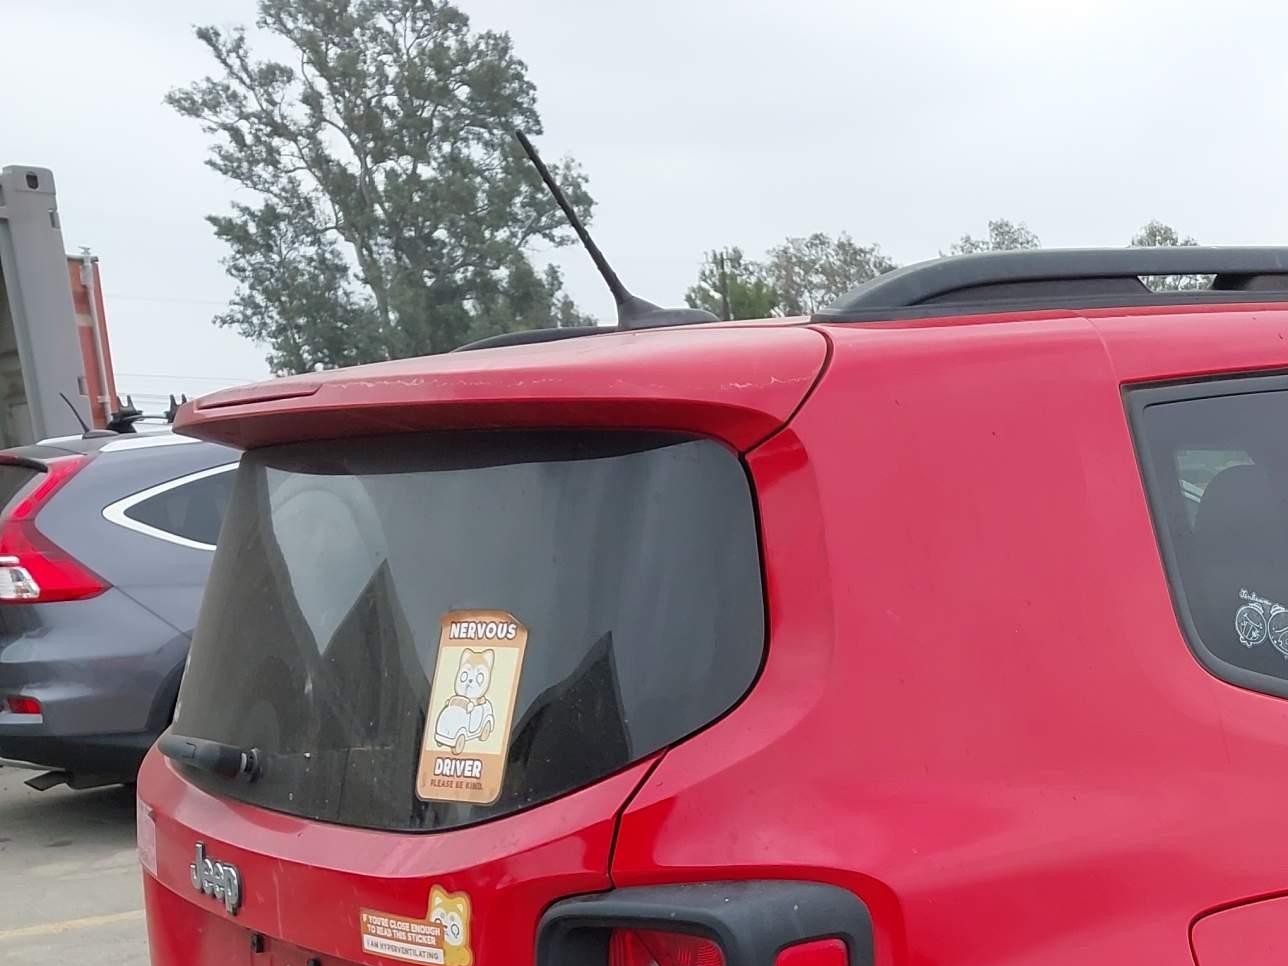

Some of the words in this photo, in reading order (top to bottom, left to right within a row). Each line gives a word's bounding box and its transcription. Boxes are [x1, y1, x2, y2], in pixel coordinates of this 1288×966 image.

[449, 620, 518, 640] NERVOUS
[433, 757, 482, 778] DRIVER
[430, 778, 454, 789] PLEASE
[455, 780, 464, 789] BE
[190, 841, 241, 915] Jeep
[367, 925, 376, 933] TO
[393, 930, 407, 940] THIS
[389, 920, 410, 930] CLOSE
[411, 924, 441, 936] ENOUGH
[370, 941, 379, 949] AM
